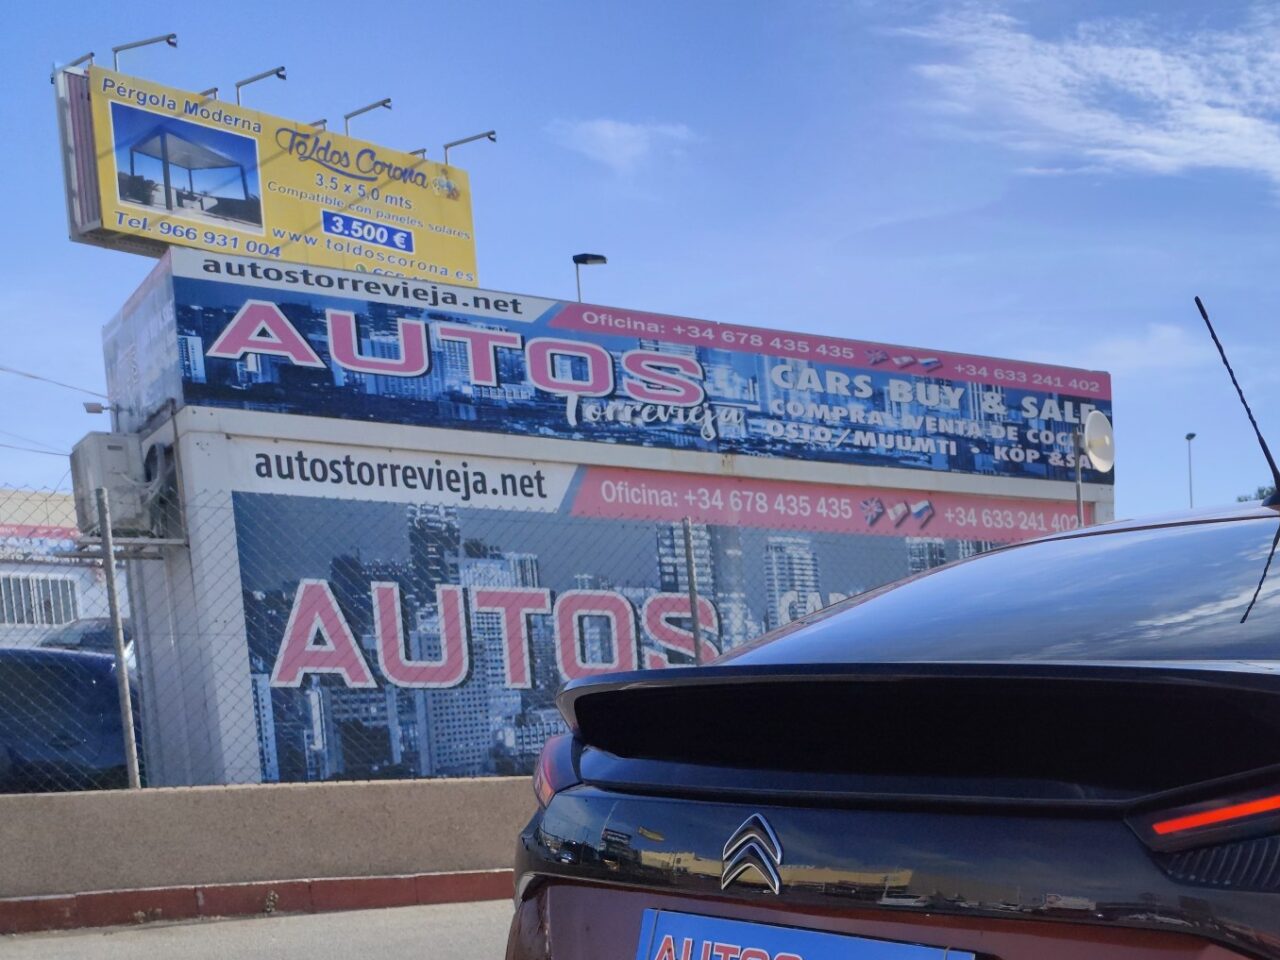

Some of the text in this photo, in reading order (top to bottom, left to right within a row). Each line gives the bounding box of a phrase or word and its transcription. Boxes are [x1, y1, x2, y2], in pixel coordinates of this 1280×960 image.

[102, 78, 262, 134] Pérgola Moderna
[275, 127, 428, 190] Toldos Corona
[267, 181, 471, 241] Compatible con paneles solares
[385, 194, 413, 210] mts
[114, 211, 282, 259] Tel. 966 931 004
[330, 215, 389, 244] 3.500
[202, 257, 524, 316] autostorrevieja.net
[206, 299, 706, 407] AUTOS
[582, 311, 855, 361] Oficina: +34 678 435 435
[770, 364, 874, 399] CARS
[888, 378, 966, 410] BUY
[981, 390, 1008, 416] &
[953, 364, 1100, 393] +34 633 241 402
[557, 391, 745, 441] Torrevieja
[771, 398, 884, 427] COMPRA
[904, 414, 982, 440] VENTA
[990, 424, 1019, 441] DE
[255, 450, 548, 501] autostorrevieja.net
[993, 443, 1040, 464] KÖP
[601, 480, 853, 520] Oficina: +34 678 435 435
[944, 506, 978, 528] +34
[981, 508, 1015, 529] 633
[1018, 511, 1048, 532] 241
[270, 578, 720, 689] AUTOS
